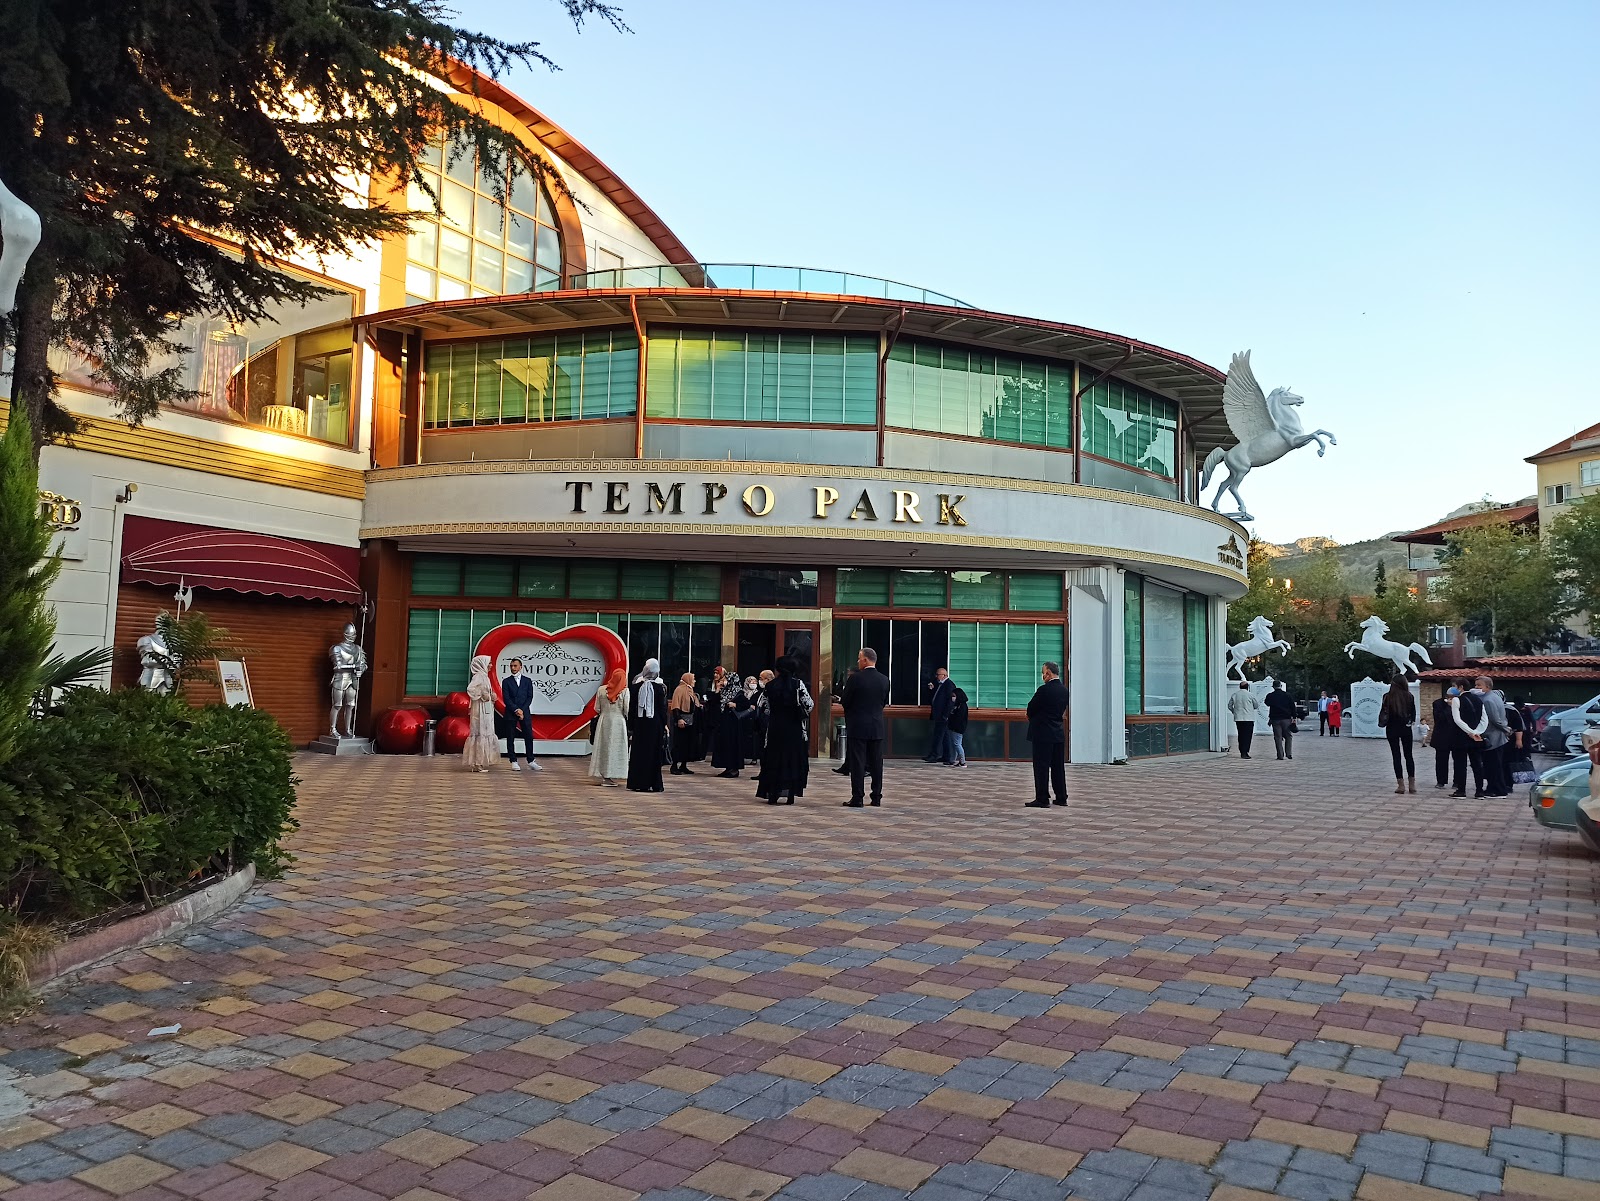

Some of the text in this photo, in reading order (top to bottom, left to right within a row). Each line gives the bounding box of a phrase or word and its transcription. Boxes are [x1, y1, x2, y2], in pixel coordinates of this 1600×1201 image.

[565, 481, 970, 526] TEMPO PARK
[501, 664, 602, 676] TMPO PARK
